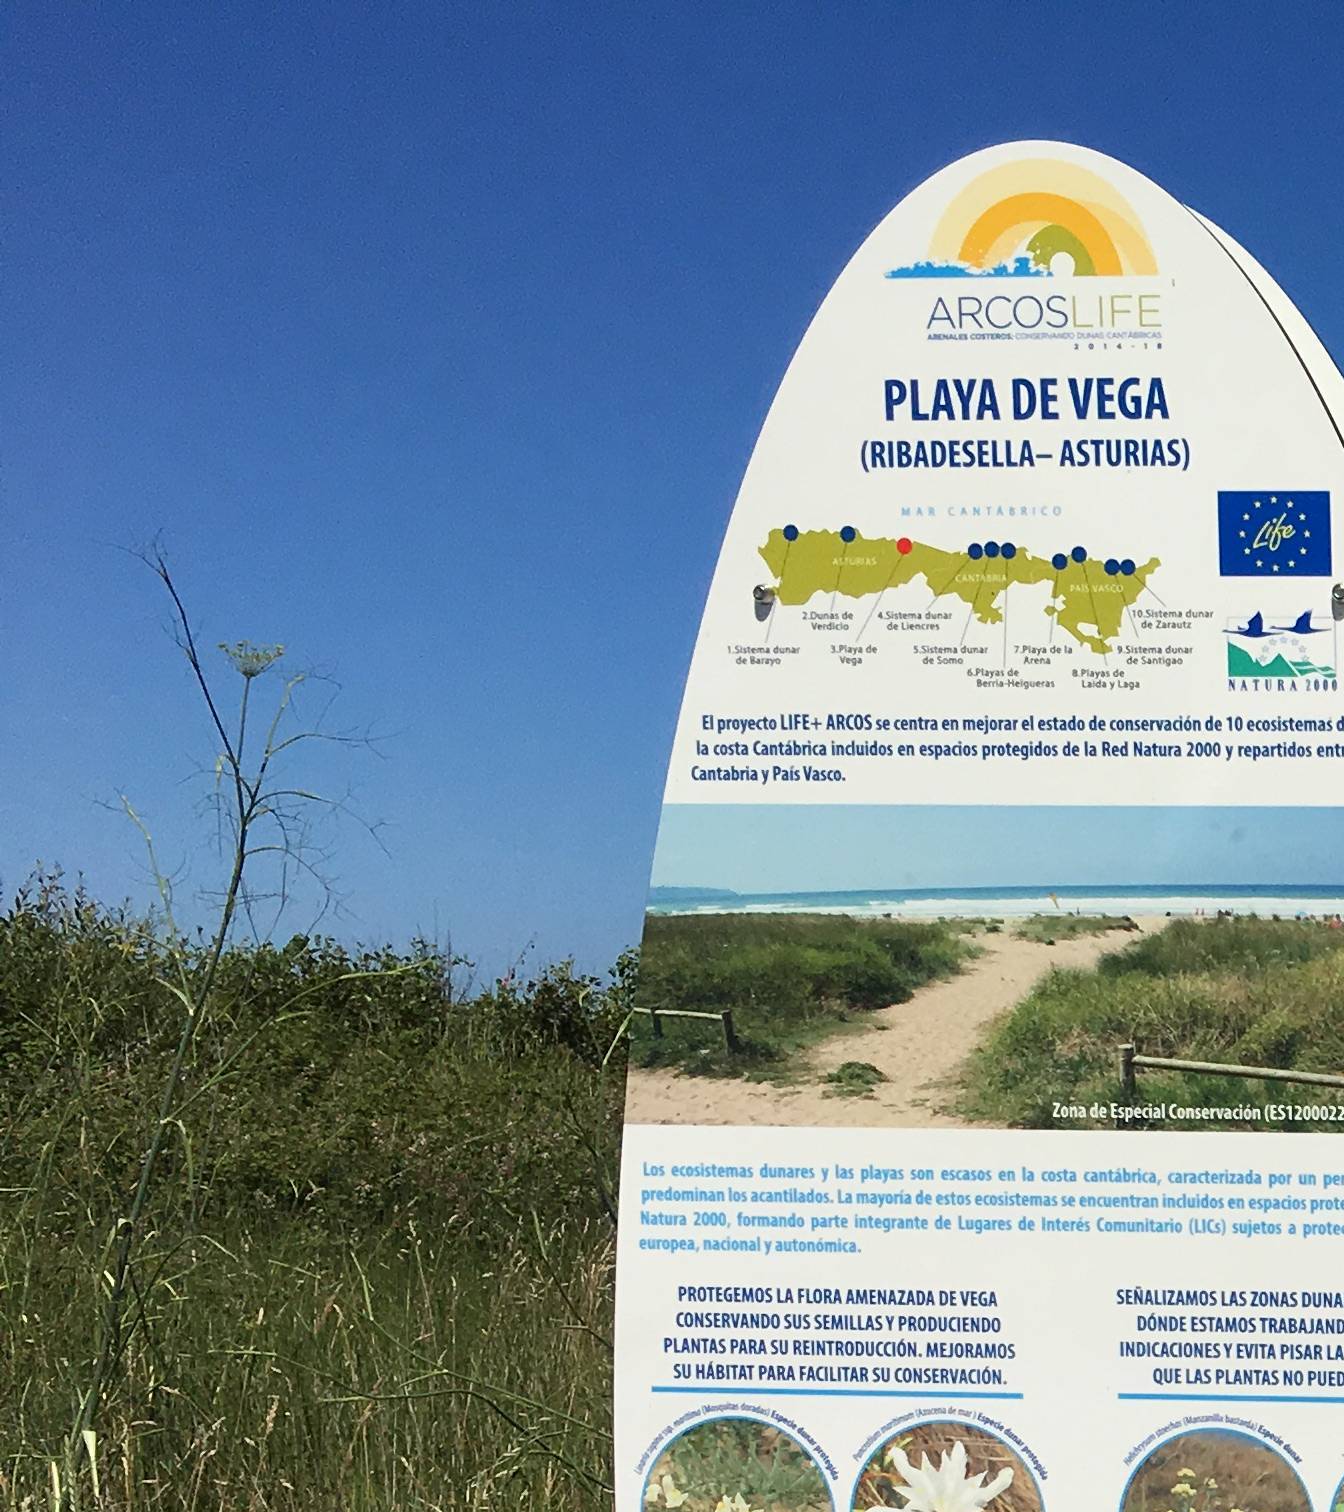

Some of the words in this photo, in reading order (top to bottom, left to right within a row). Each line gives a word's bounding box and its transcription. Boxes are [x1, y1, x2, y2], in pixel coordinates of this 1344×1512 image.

[927, 295, 1158, 329] ARCOSLIFE
[884, 378, 1000, 420] PLAYA
[1011, 378, 1059, 420] DE
[1067, 377, 1169, 419] VEGA
[1059, 439, 1189, 469] ASTURIAS)
[901, 506, 935, 516] MAR
[947, 505, 1061, 516] CANTÁBRICO
[1252, 513, 1295, 551] Life
[831, 557, 877, 565] ASTURIAS
[954, 573, 1007, 583] CANTABRIA
[1069, 583, 1089, 592] PAÍS
[1091, 583, 1124, 593] VASCO
[802, 611, 839, 620] 2.Dunas
[841, 611, 853, 620] de
[877, 611, 922, 619] 4.Sistema
[925, 611, 952, 619] dunar
[1132, 609, 1182, 618] 10.Sistema
[1185, 609, 1214, 618] dunar
[810, 622, 849, 630] Verdicio
[886, 622, 898, 630] de
[901, 622, 940, 630] Liencres
[1140, 620, 1153, 629] de
[1155, 620, 1191, 629] Zarautz
[727, 645, 770, 654] 1.Sistema
[772, 645, 800, 654] dunar
[830, 645, 863, 655] 3.Playa
[865, 645, 877, 654] de
[913, 645, 958, 654] 5.Sistema
[960, 645, 988, 654] dunar
[1014, 645, 1047, 657] 7.Playa
[1049, 645, 1062, 654] de
[1064, 644, 1072, 654] la
[1116, 645, 1162, 654] 9.Sistema
[1164, 645, 1193, 654] dunar
[735, 656, 747, 664] de
[749, 656, 781, 665] Barayo
[839, 655, 862, 666] Vega
[922, 656, 934, 664] de
[936, 656, 963, 664] Somo
[1023, 656, 1051, 664] Arena
[966, 668, 1004, 678] 6.Playas
[1006, 668, 1019, 677] de
[1071, 668, 1110, 679] 8.Playas
[1112, 669, 1124, 677] de
[1081, 679, 1107, 688] Laida
[1109, 681, 1115, 690] y
[1117, 679, 1140, 690] Laga
[1228, 678, 1297, 691] NATURA
[1305, 678, 1337, 691] 2000
[691, 765, 758, 781] Cantabria
[761, 769, 769, 785] y
[772, 765, 800, 781] País
[802, 765, 845, 781] Vasco.
[1052, 1102, 1086, 1118] Zona
[1089, 1102, 1108, 1122] de
[1109, 1102, 1165, 1123] Especial
[1165, 1103, 1261, 1121] Conservación
[638, 1238, 699, 1253] europea,
[703, 1237, 760, 1251] nacional
[764, 1240, 772, 1255] y
[774, 1238, 861, 1253] autonómica.
[678, 1286, 773, 1303] PROTEGEMOS
[776, 1287, 793, 1303] LA
[797, 1288, 842, 1304] FLORA
[845, 1289, 935, 1305] AMENAZADA
[939, 1290, 957, 1306] DE
[959, 1290, 997, 1307] VEGA
